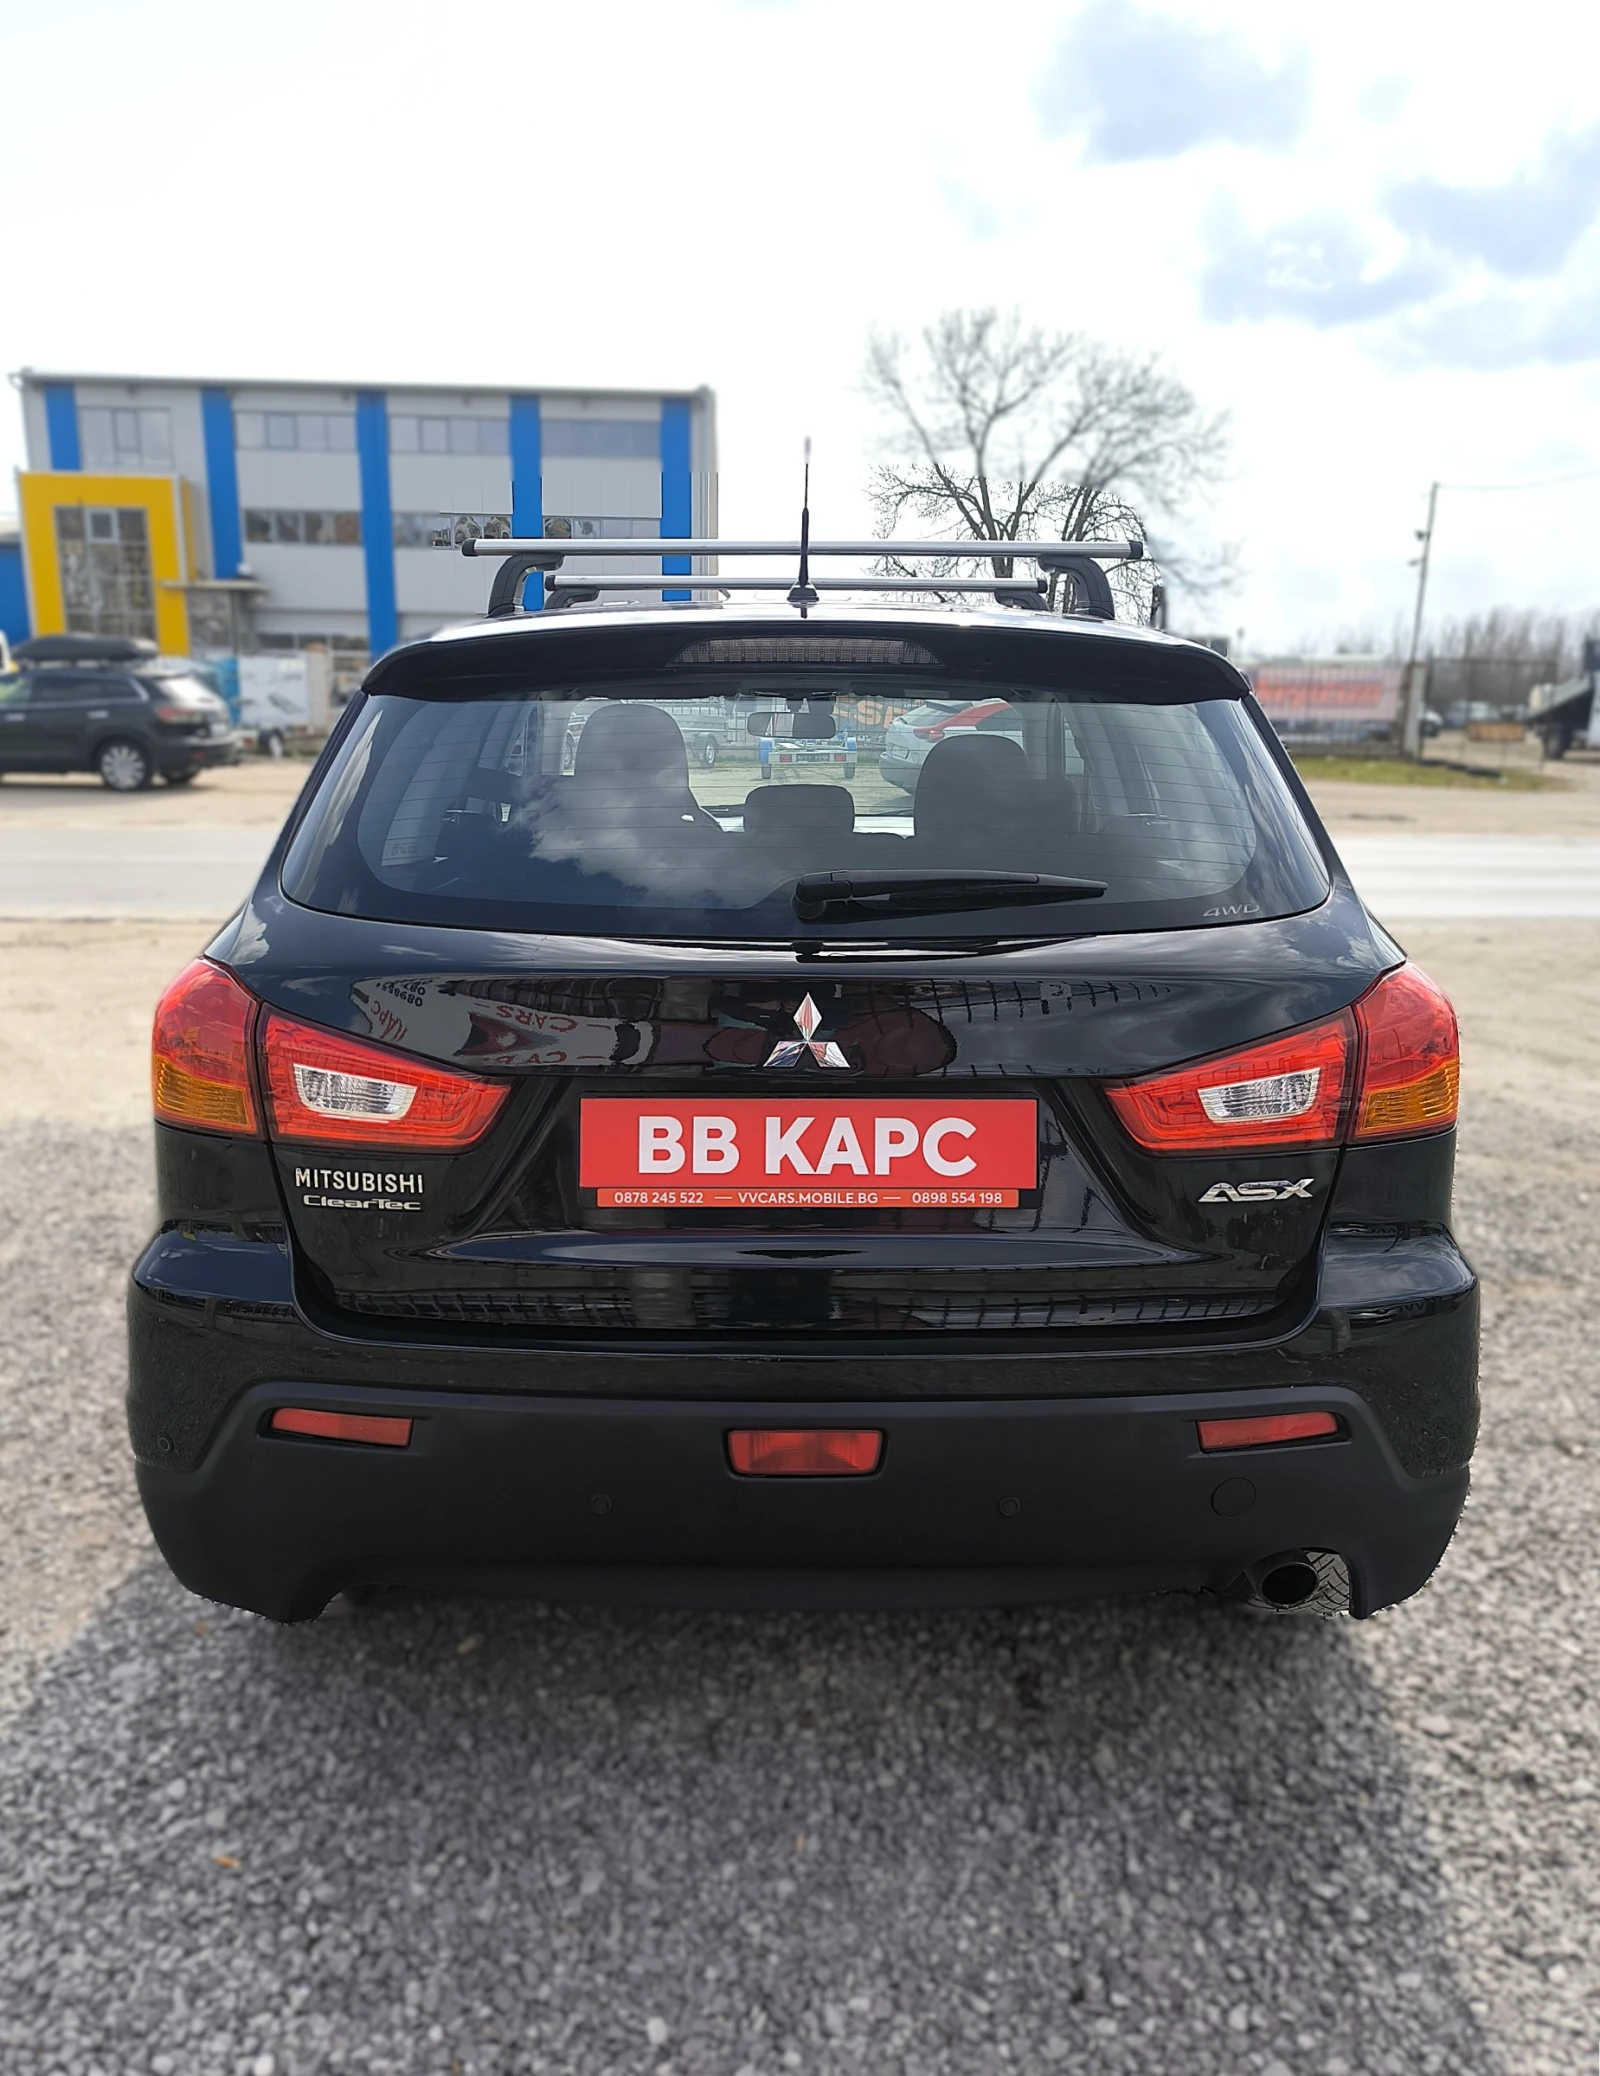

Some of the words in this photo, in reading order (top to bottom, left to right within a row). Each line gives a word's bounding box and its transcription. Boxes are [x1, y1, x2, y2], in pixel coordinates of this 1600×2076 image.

[1203, 904, 1260, 917] 4WD
[295, 1167, 423, 1194] MITSUBISHI
[614, 1191, 649, 1204] 0878
[651, 1191, 678, 1204] 245
[679, 1191, 704, 1204] 522
[737, 1191, 878, 1205] VVCARS.MOBILE.BG
[911, 1192, 948, 1204] 0898
[951, 1192, 976, 1204] 554
[979, 1192, 1003, 1204] 198
[1198, 1178, 1315, 1202] ASX
[303, 1194, 421, 1211] ClearTec
